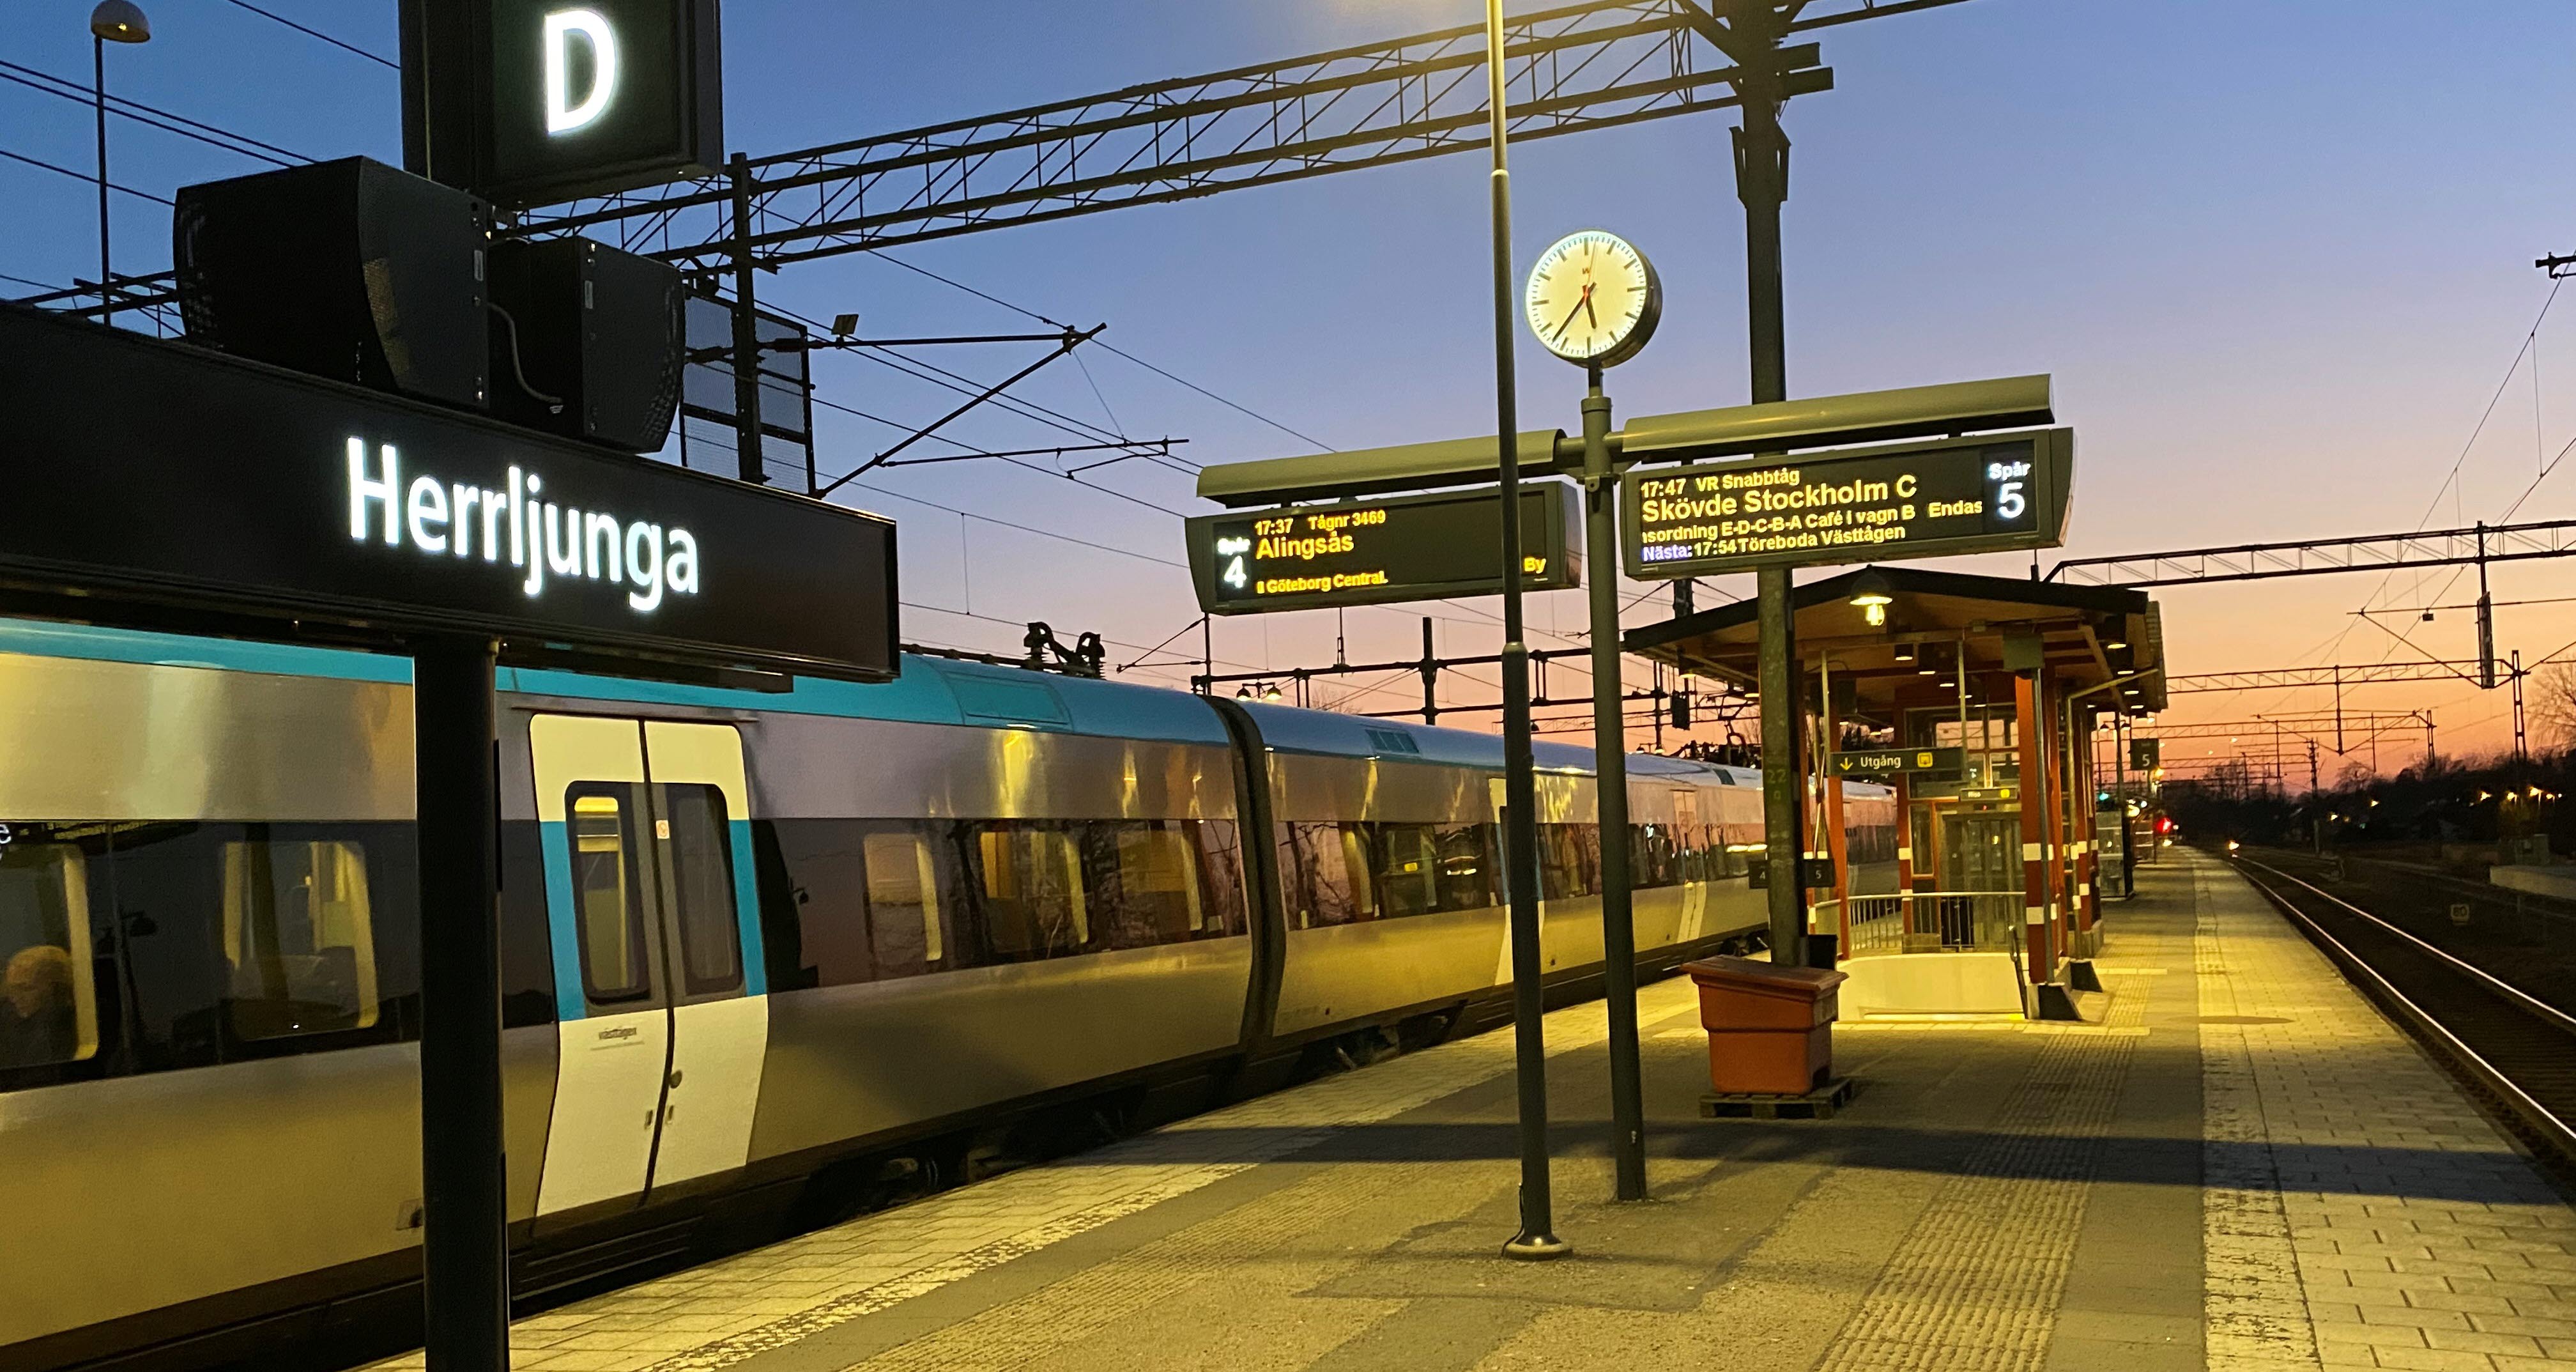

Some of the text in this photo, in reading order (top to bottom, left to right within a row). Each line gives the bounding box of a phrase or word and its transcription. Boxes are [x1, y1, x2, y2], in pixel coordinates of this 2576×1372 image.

[544, 10, 617, 134] D
[1641, 468, 1800, 498] 17:47 VR Snabbtåg
[1988, 461, 2031, 481] Spår
[1642, 474, 1917, 522] Skövde Stockholm C
[1998, 482, 2025, 518] 5
[348, 436, 699, 612] Herrljunga
[1255, 510, 1386, 536] 17:37 Tågnr 3469
[1721, 515, 1802, 537] E-D-C-B-A
[1805, 510, 1843, 528] Café
[1855, 508, 1898, 526] vagn
[1901, 504, 1915, 520] B
[1929, 500, 1982, 518] Endas
[1255, 530, 1354, 560] Alingsås
[1643, 525, 1905, 561] Nästa: 17:54 Töreboda Västtågen
[1224, 555, 1247, 588] 4
[1266, 577, 1331, 593] Göteborg
[1524, 557, 1546, 574] By
[1860, 755, 1901, 769] Utgång
[2142, 754, 2150, 766] 5
[1816, 870, 1821, 879] 5
